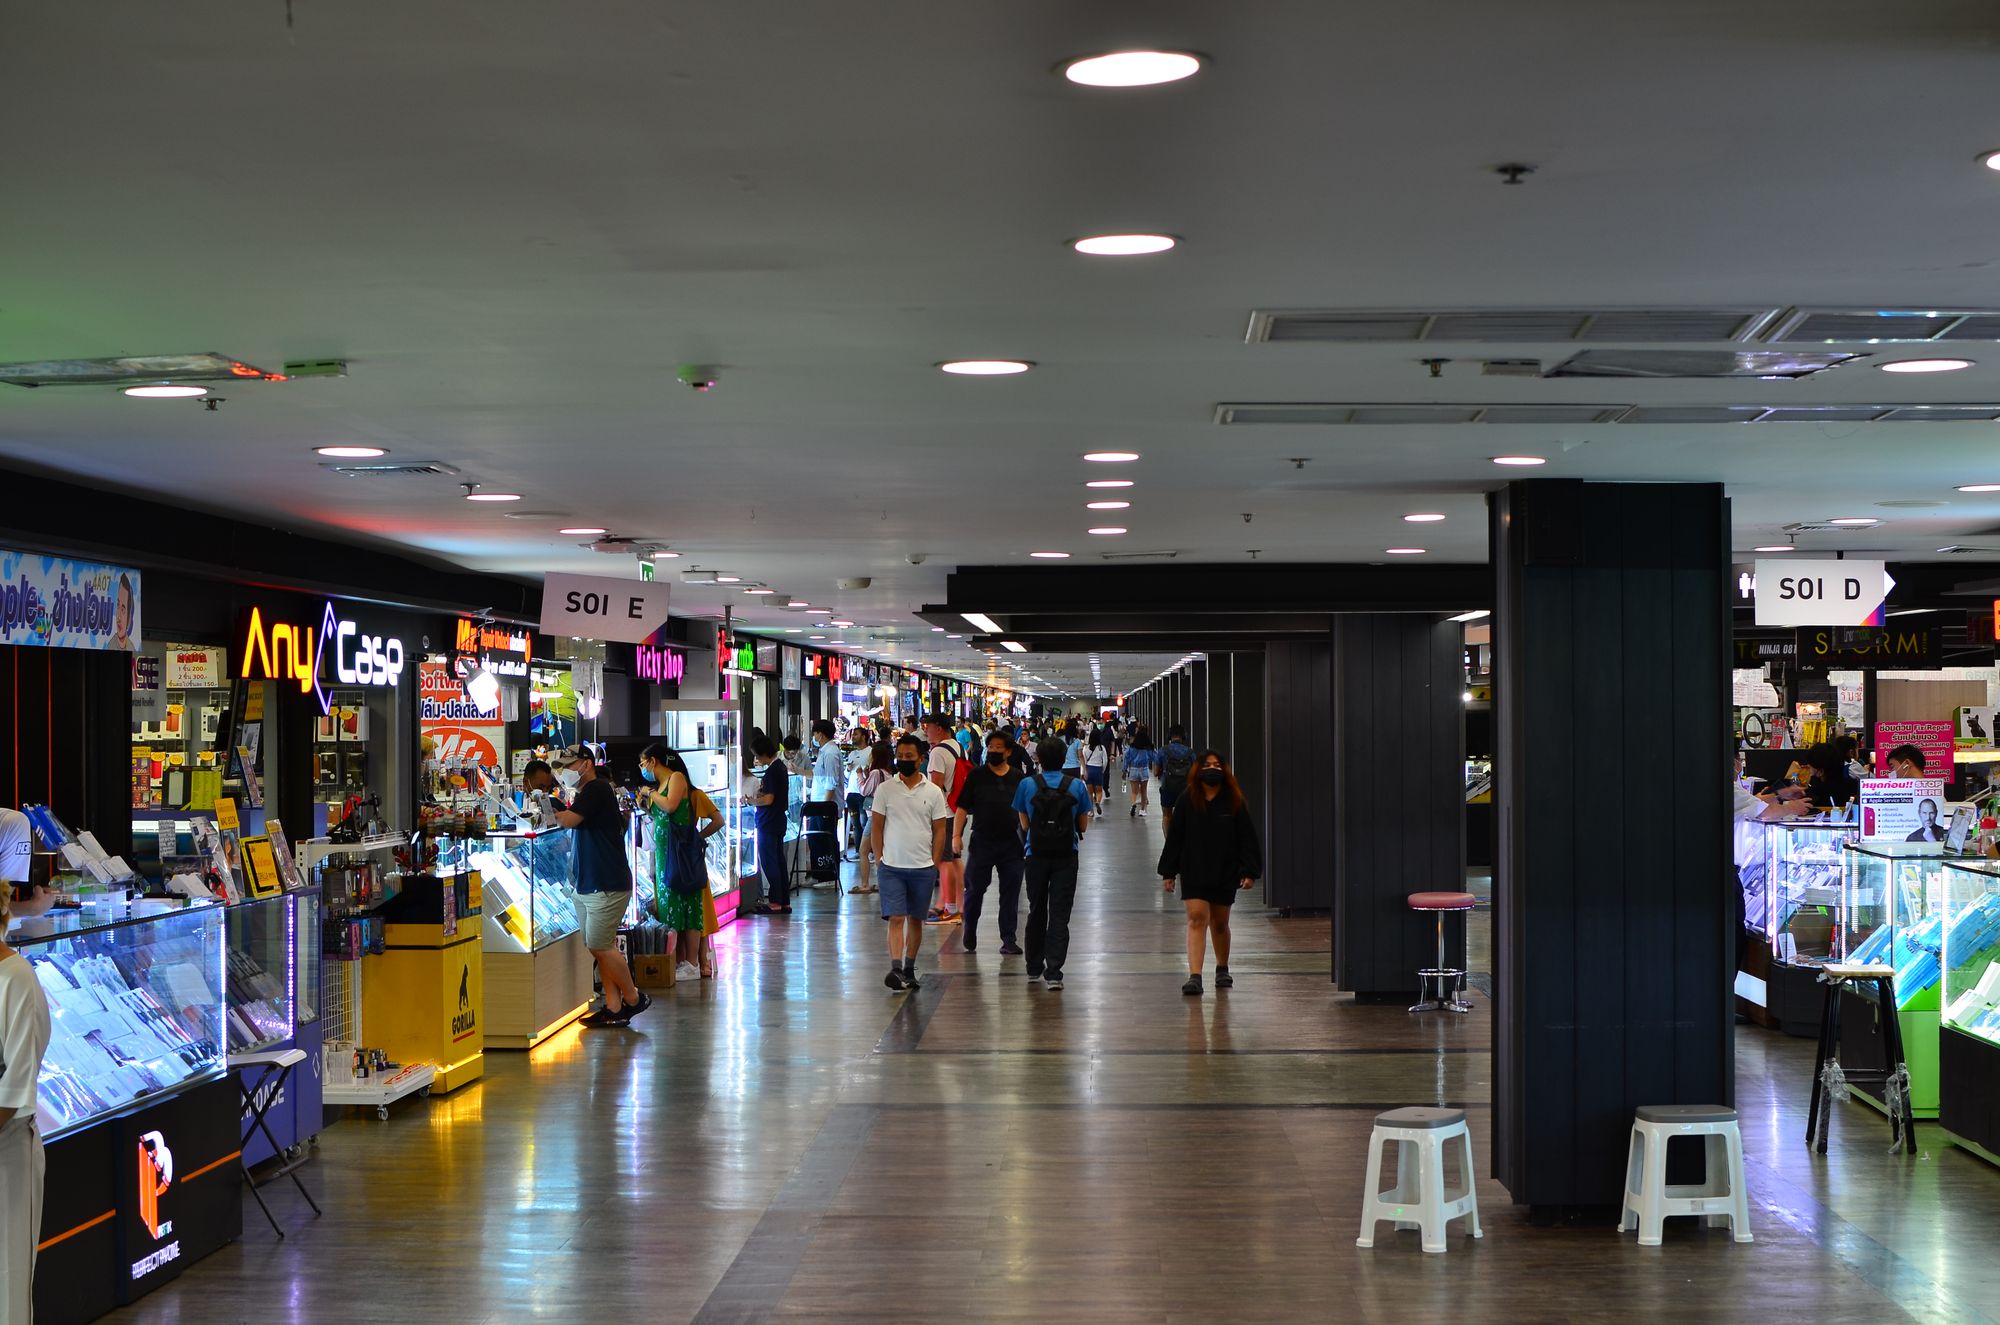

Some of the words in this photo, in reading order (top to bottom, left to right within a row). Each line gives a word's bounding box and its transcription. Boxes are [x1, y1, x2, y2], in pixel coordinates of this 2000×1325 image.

[1778, 578, 1823, 600] SOI
[1844, 578, 1861, 600] D
[565, 591, 608, 616] SOI
[628, 597, 644, 619] E
[241, 606, 313, 693] Any
[336, 620, 404, 686] Case
[1758, 644, 1781, 655] NINJA
[636, 645, 662, 685] Vicky
[663, 648, 683, 686] Shop
[452, 1008, 476, 1036] GORILLA
